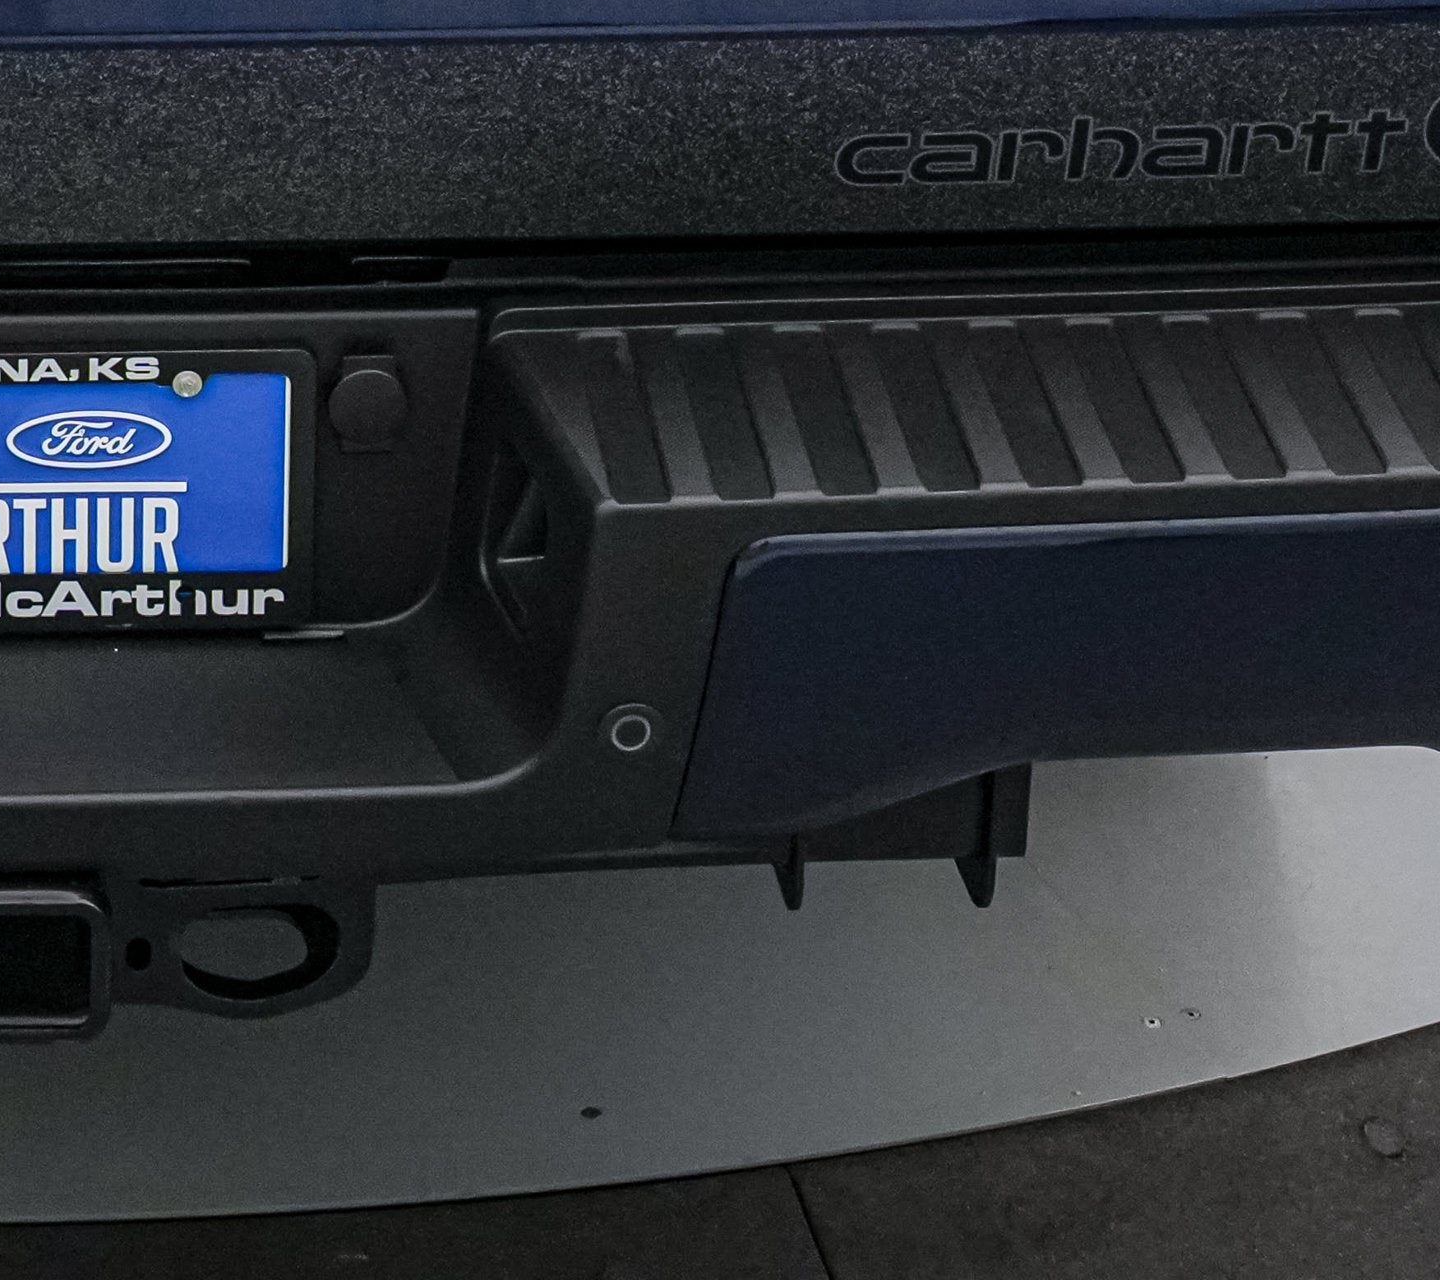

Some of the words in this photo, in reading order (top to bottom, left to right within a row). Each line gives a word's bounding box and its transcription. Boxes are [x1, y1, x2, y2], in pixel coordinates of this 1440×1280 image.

[833, 108, 1410, 187] carhartt
[88, 357, 161, 381] KS
[40, 419, 136, 456] Ford
